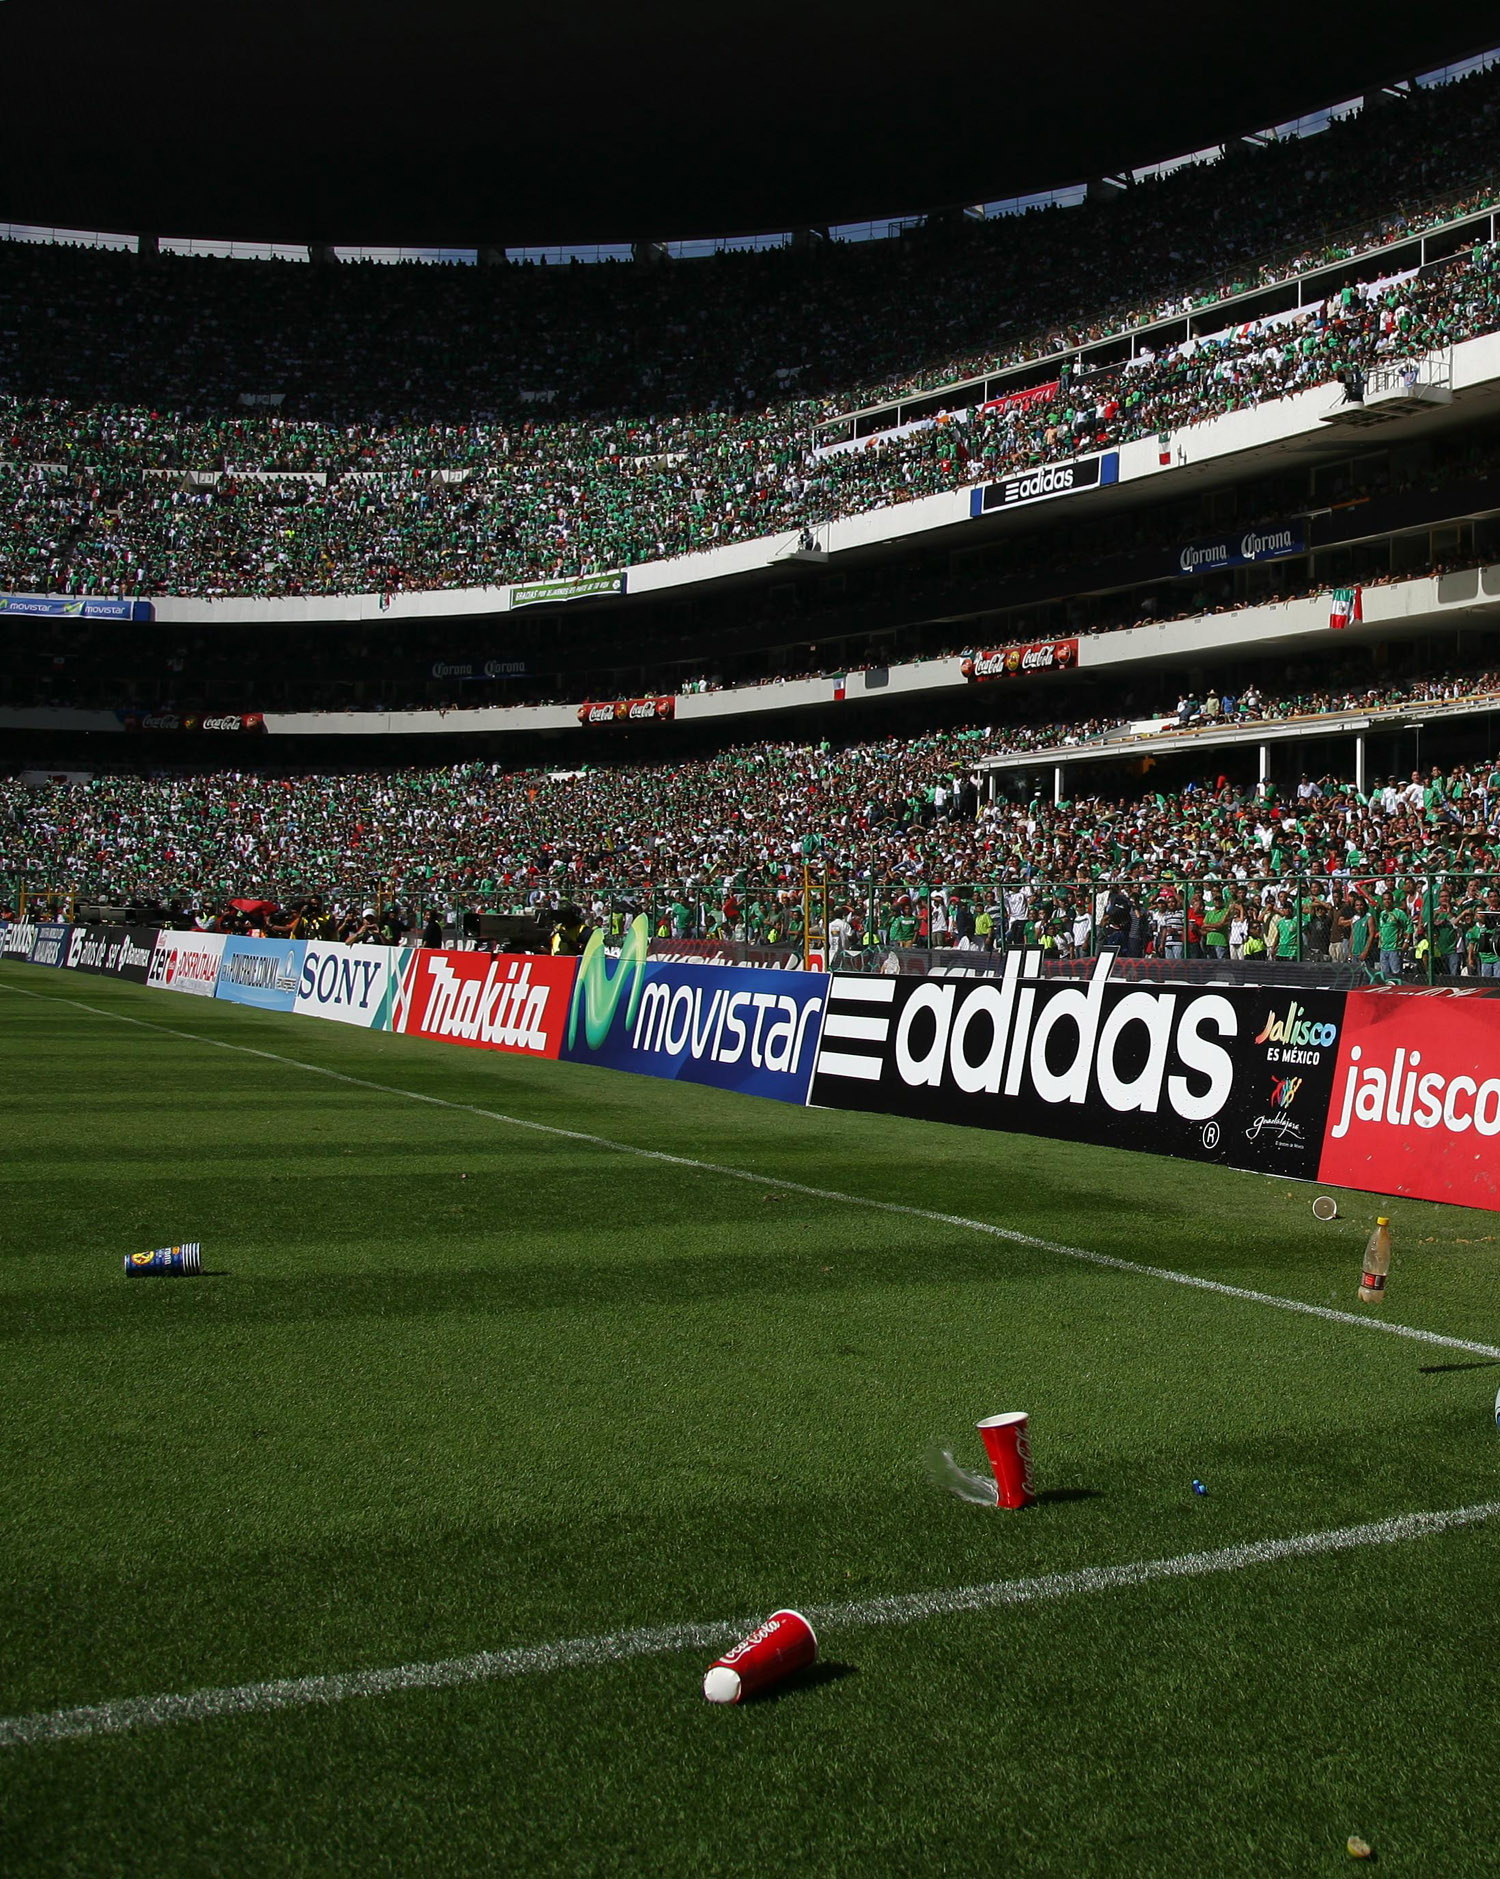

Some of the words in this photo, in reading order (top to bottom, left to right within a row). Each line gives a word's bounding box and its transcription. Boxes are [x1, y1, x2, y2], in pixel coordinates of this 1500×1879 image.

[1019, 464, 1074, 500] adidas
[1241, 531, 1292, 560] Corona
[1180, 544, 1227, 573] Corona
[10, 602, 52, 612] movistar
[85, 605, 125, 614] movistar
[974, 653, 1006, 676] Coca-Cola
[1022, 644, 1055, 669] Coca-Cola
[432, 662, 472, 679] Corona
[484, 659, 526, 676] Corona
[588, 704, 615, 722] Coca-Cola
[629, 701, 657, 719] Coca-Cola
[203, 715, 241, 731] Coca-Cola
[299, 951, 381, 1009] SONY
[632, 982, 823, 1075] movistar
[895, 944, 1239, 1121] adidas
[1266, 1047, 1280, 1062] ES
[1281, 1046, 1320, 1066] MÉXICO
